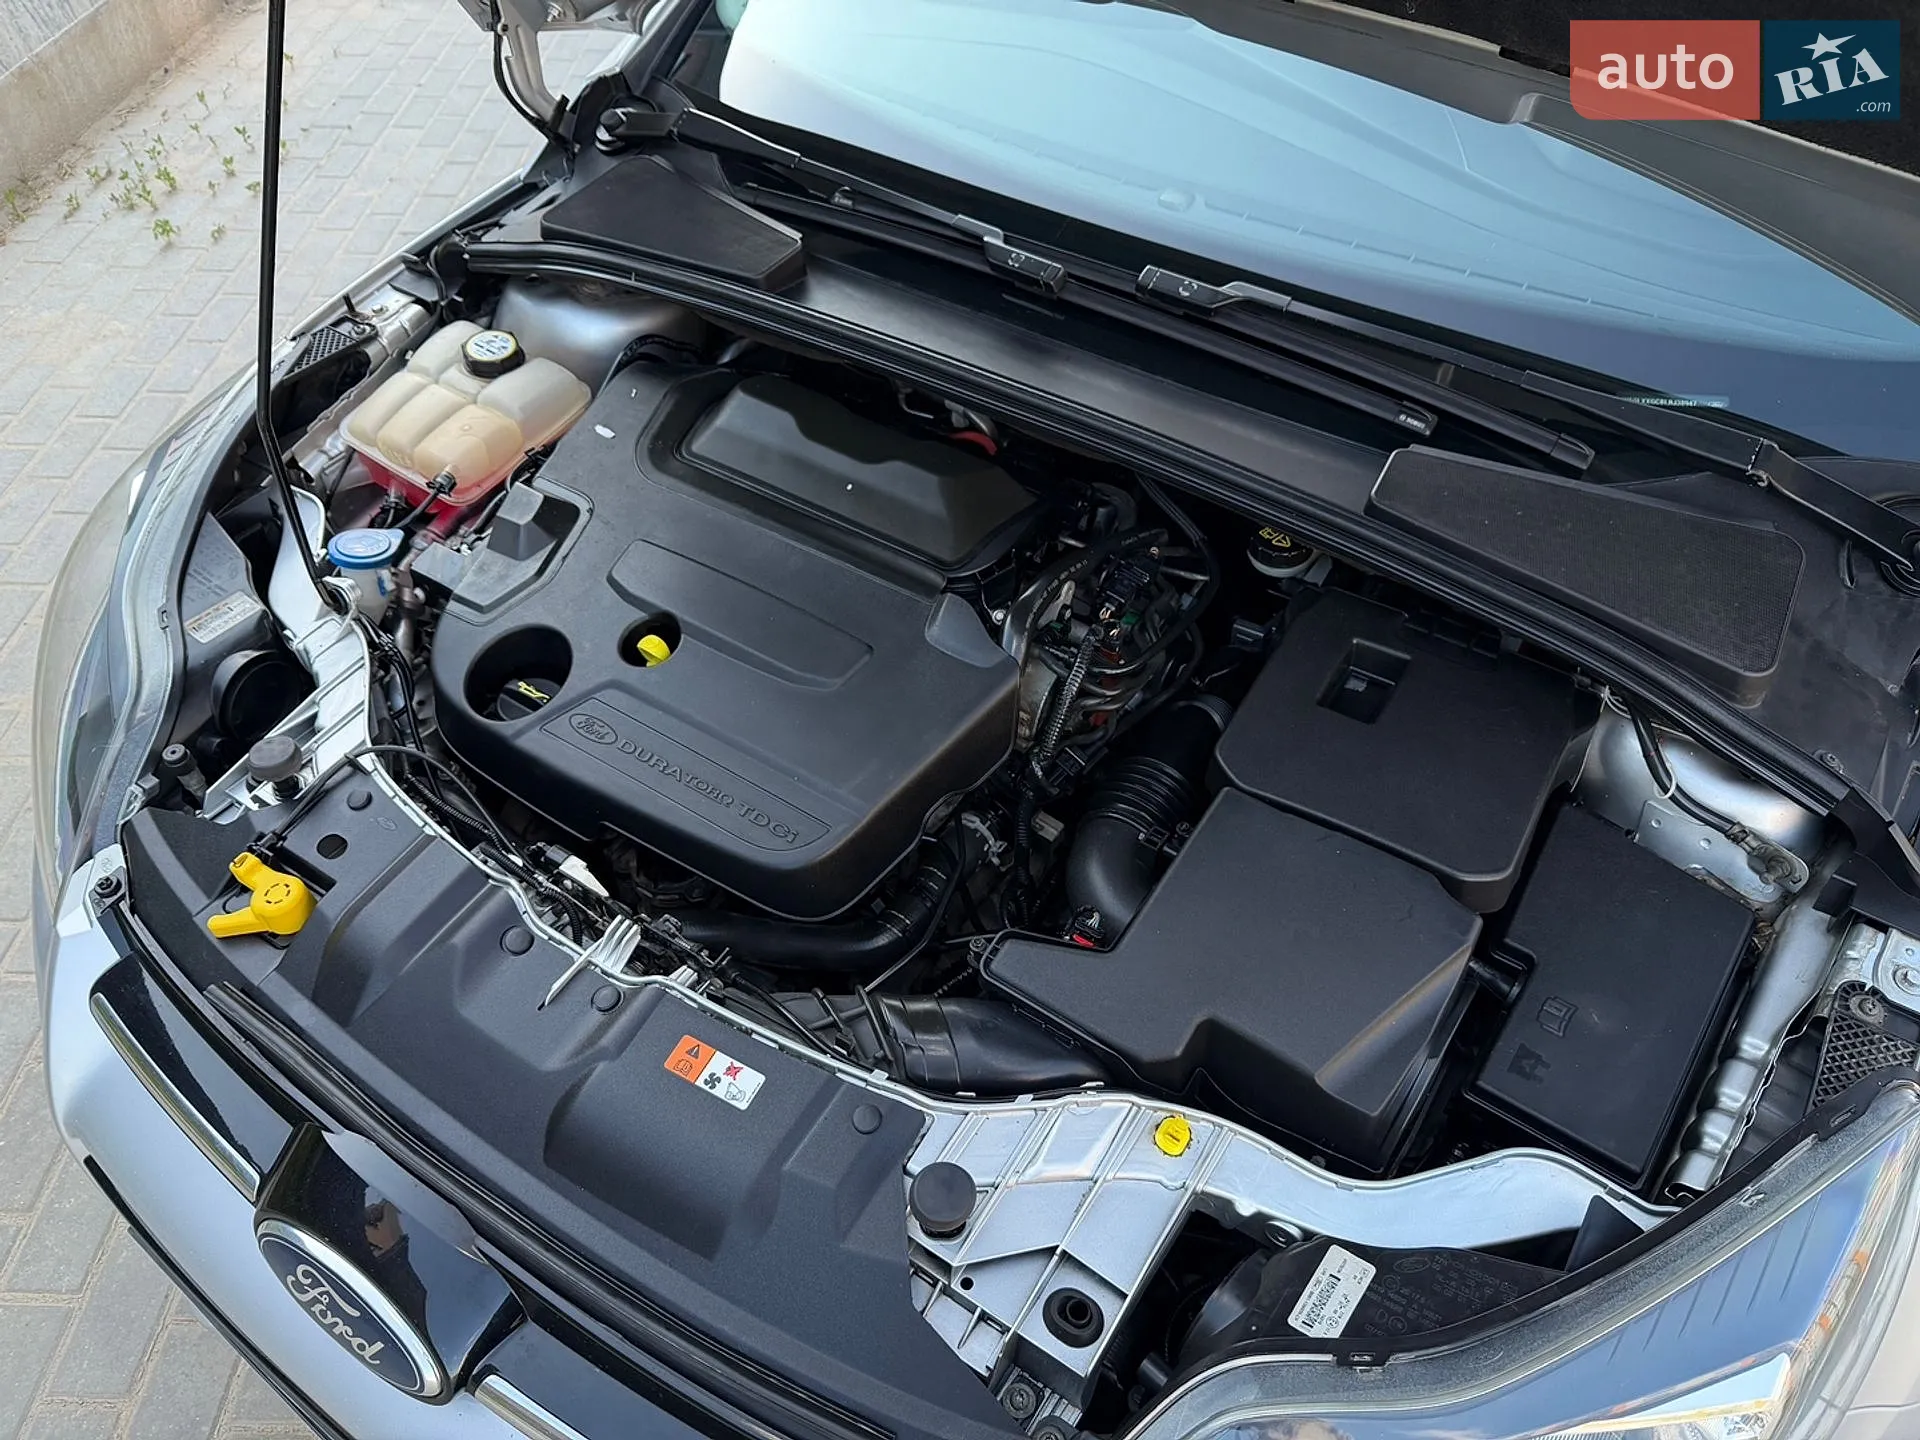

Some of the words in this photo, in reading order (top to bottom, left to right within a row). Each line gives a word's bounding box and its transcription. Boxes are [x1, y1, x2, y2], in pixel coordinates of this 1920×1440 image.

[617, 739, 735, 809] DURATORQ
[738, 803, 801, 844] TDCi
[286, 1263, 385, 1365] Ford
